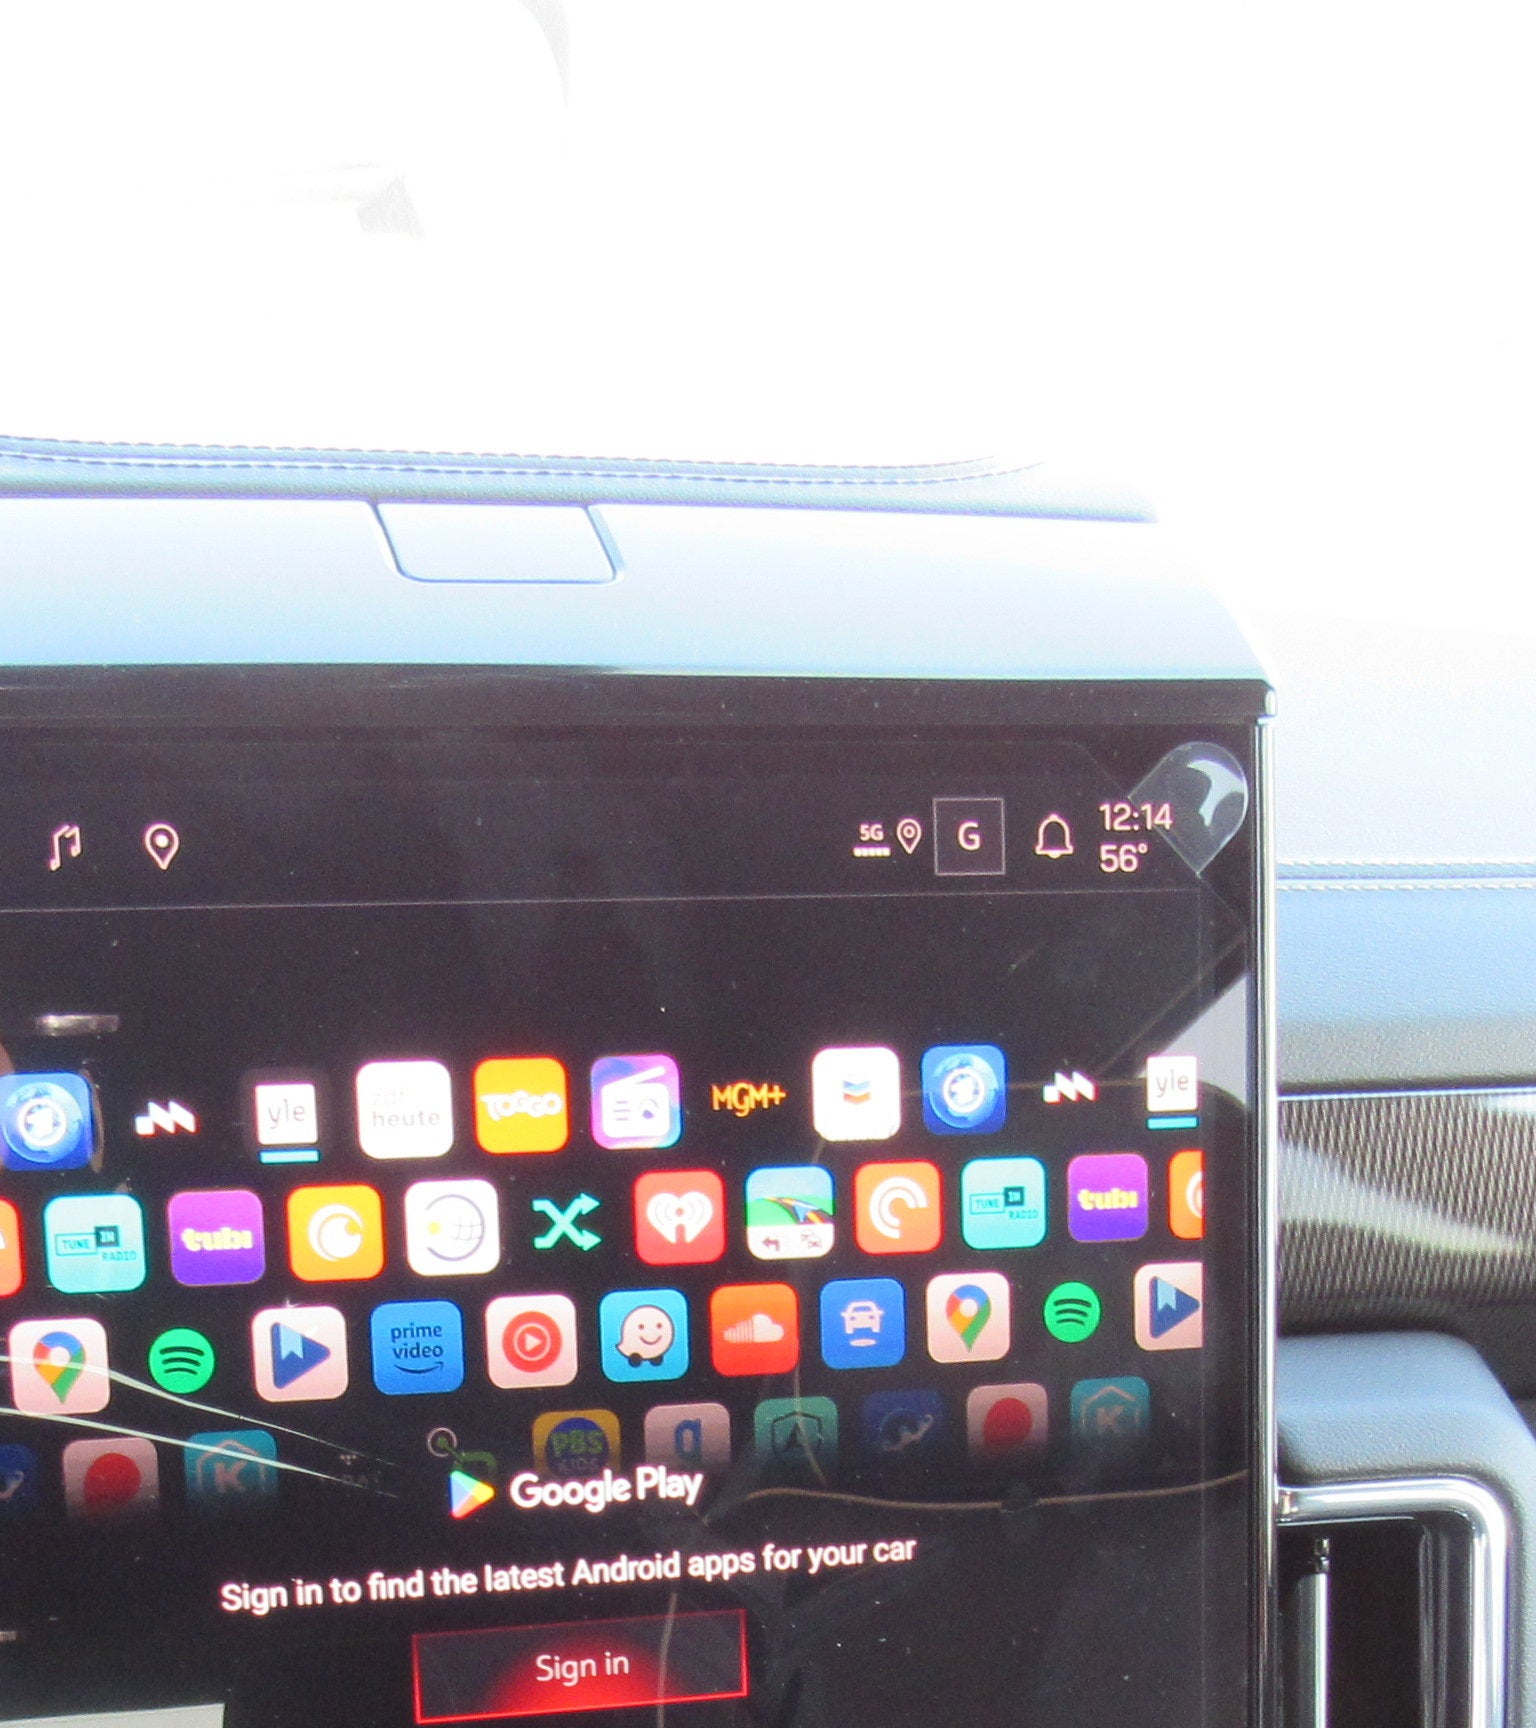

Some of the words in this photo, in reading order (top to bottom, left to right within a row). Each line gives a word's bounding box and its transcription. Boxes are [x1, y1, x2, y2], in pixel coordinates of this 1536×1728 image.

[1099, 802, 1173, 831] 12:14
[859, 824, 884, 842] 5G
[957, 821, 981, 851] G
[1156, 1069, 1190, 1099] yle
[267, 1098, 306, 1131] yle
[711, 1083, 787, 1117] MGM+
[371, 1109, 441, 1128] heute
[62, 1239, 91, 1250] TUNE
[101, 1250, 138, 1262] RADIO
[390, 1322, 443, 1343] prime
[392, 1342, 444, 1360] video
[509, 1470, 632, 1514] Google
[636, 1464, 704, 1506] Play
[220, 1582, 288, 1616] Sign
[295, 1579, 323, 1606] in
[329, 1576, 363, 1604] to
[368, 1570, 425, 1600] find
[431, 1566, 478, 1595] the
[483, 1560, 565, 1592] latest
[570, 1552, 682, 1588] Android
[687, 1553, 756, 1585] apps
[762, 1543, 803, 1572] for
[808, 1541, 868, 1571] your
[872, 1537, 917, 1564] car
[535, 1653, 597, 1688] Sign
[604, 1651, 630, 1677] in
